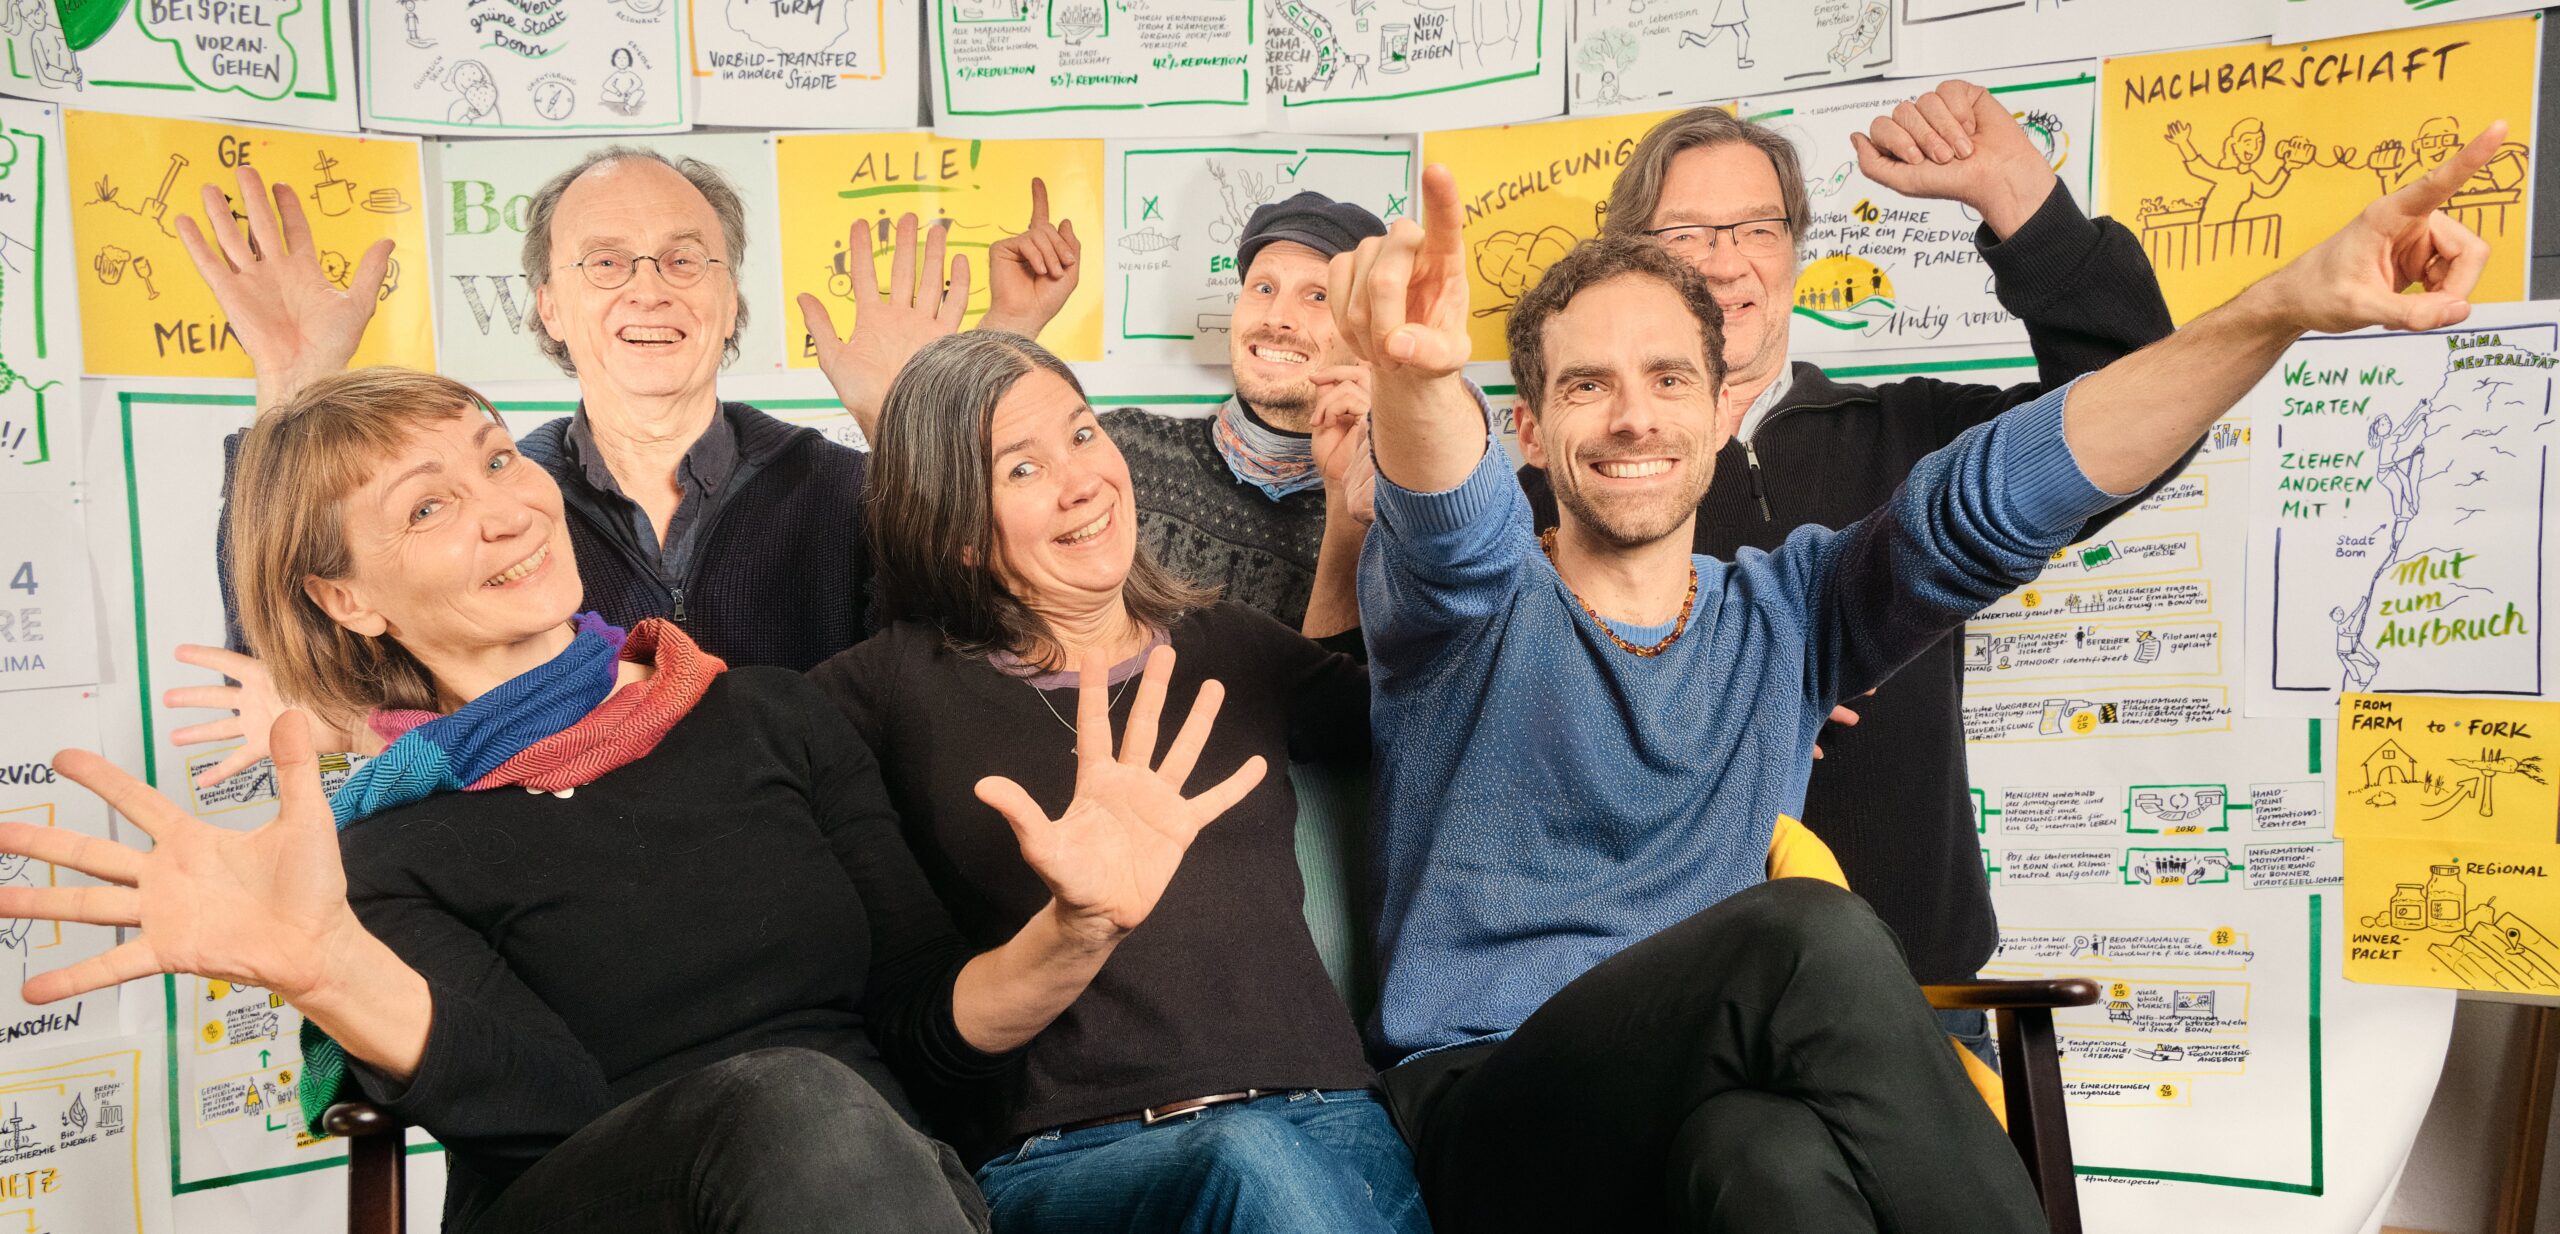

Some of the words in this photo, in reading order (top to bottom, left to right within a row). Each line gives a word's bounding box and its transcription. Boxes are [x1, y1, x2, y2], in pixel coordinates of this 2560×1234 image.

[1813, 2, 1849, 20] Energie
[470, 7, 516, 34] grüne
[521, 10, 567, 35] Stadt
[494, 30, 549, 57] Bonn
[1413, 27, 1444, 44] NEN
[211, 54, 281, 83] GEHEN
[1179, 53, 1249, 68] REDUKTION
[722, 69, 735, 81] in
[738, 68, 785, 80] andere
[785, 69, 838, 90] STÄDTE
[1076, 73, 1139, 86] REDUKTION
[2123, 41, 2471, 110] NACHBARSCHAFT
[218, 135, 251, 168] GE
[1853, 200, 1879, 223] 10
[1878, 208, 1929, 226] JAHRE
[1875, 225, 1903, 240] ein
[1825, 244, 1853, 263] auf
[1858, 241, 1906, 257] diesem
[1118, 259, 1172, 272] WENIGER
[2284, 359, 2349, 388] WENN
[2278, 475, 2374, 494] ANDEREN
[2335, 534, 2376, 547] Stadt
[2335, 546, 2367, 559] Bonn
[2392, 551, 2480, 587] Mut
[9, 561, 39, 597] 4
[2379, 589, 2443, 617] zum
[2353, 700, 2393, 712] FROM
[2351, 714, 2404, 732] FARM
[2426, 720, 2447, 734] to
[2467, 718, 2533, 739] FORK
[2174, 824, 2198, 834] 2030
[2022, 861, 2049, 872] BONN
[2159, 875, 2181, 885] 2030
[2351, 946, 2404, 962] PACKT
[2184, 1025, 2213, 1035] BONN
